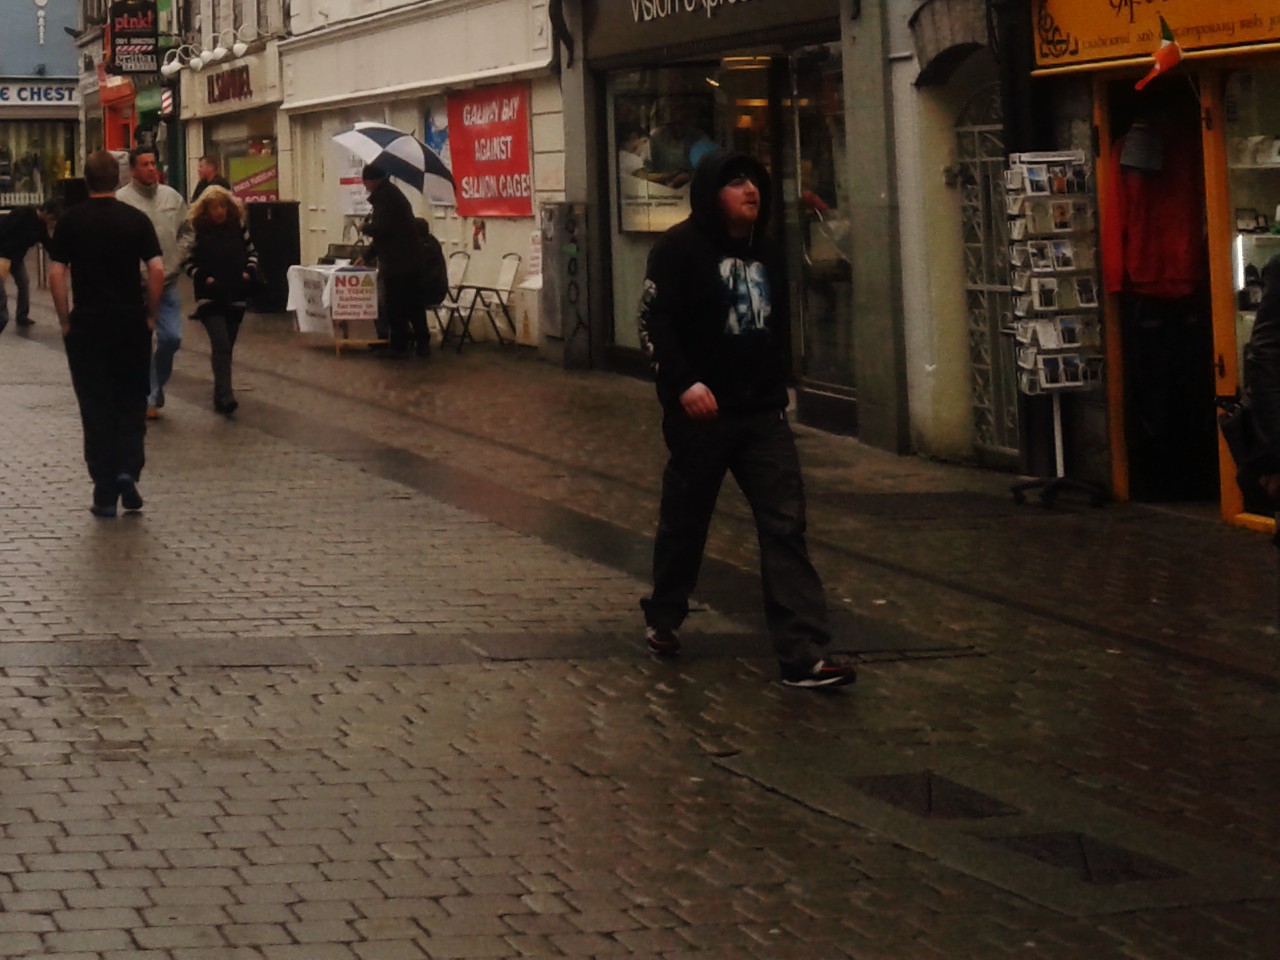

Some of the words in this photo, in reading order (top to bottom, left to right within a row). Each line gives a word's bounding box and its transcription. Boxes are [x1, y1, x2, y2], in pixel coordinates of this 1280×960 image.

[16, 86, 76, 102] CHEST
[463, 98, 500, 126] GALWAY
[501, 96, 520, 121] BAY
[474, 136, 513, 161] AGAINST
[461, 175, 498, 199] SALMON
[335, 275, 360, 288] NO
